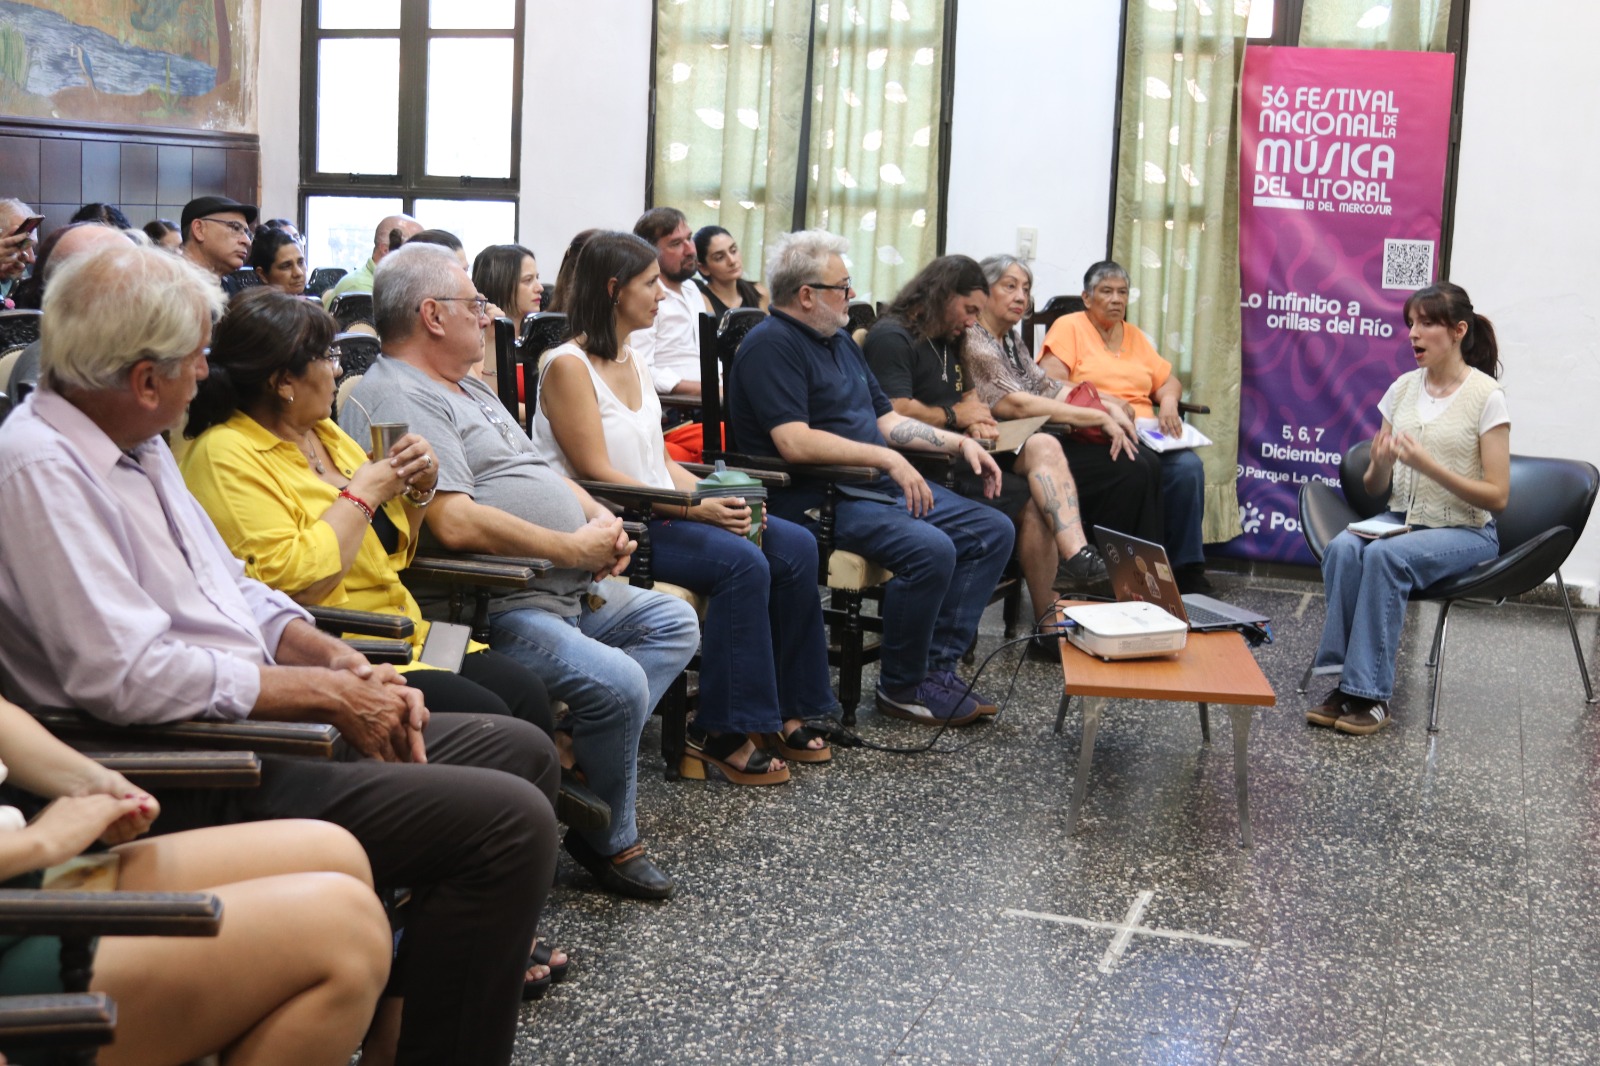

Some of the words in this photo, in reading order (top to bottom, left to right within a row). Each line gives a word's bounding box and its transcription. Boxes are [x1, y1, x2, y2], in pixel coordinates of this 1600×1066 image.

[1261, 85, 1289, 108] 56
[1295, 87, 1399, 113] FESTIVAL
[1259, 109, 1382, 138] NACIONAL
[1383, 114, 1398, 126] DE
[1382, 127, 1396, 139] LA
[1255, 135, 1395, 180] MÚSICA
[1254, 174, 1291, 197] DEL
[1302, 177, 1391, 203] LITORAL
[1305, 200, 1315, 211] 18
[1318, 202, 1335, 212] DEL
[1339, 202, 1392, 216] MERCOSUR
[1267, 290, 1341, 316] infinito
[1346, 300, 1360, 316] a
[1267, 312, 1321, 332] orillas
[1325, 315, 1355, 335] del
[1359, 317, 1393, 338] Río
[1282, 425, 1294, 442] 5,
[1298, 426, 1310, 444] 6,
[1314, 428, 1325, 442] 7
[1261, 443, 1342, 465] Diciembre
[1245, 466, 1290, 483] Parque
[1293, 472, 1308, 484] La
